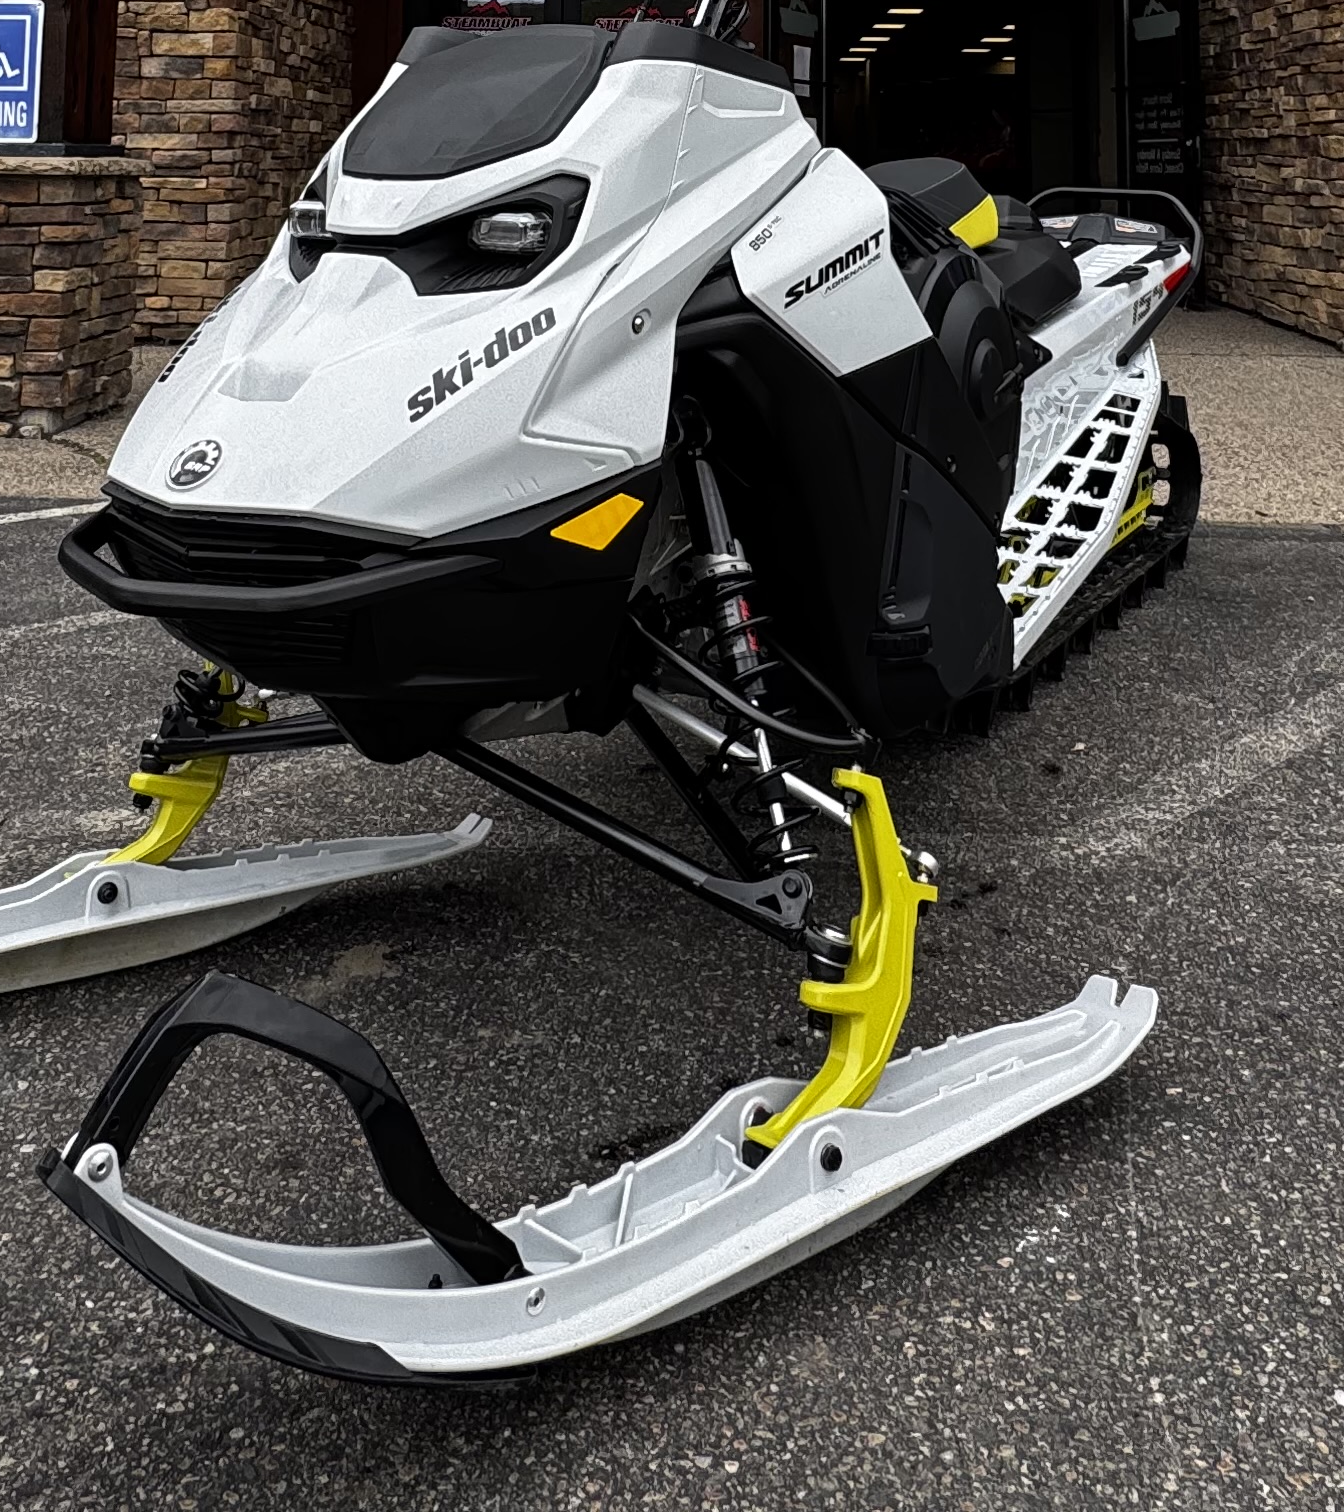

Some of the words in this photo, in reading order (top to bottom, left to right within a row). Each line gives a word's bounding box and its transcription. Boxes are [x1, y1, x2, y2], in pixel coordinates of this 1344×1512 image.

[749, 228, 773, 251] 850
[784, 228, 885, 309] SUMMIT
[824, 252, 881, 295] ADRENALINE
[407, 307, 557, 423] ski-doo
